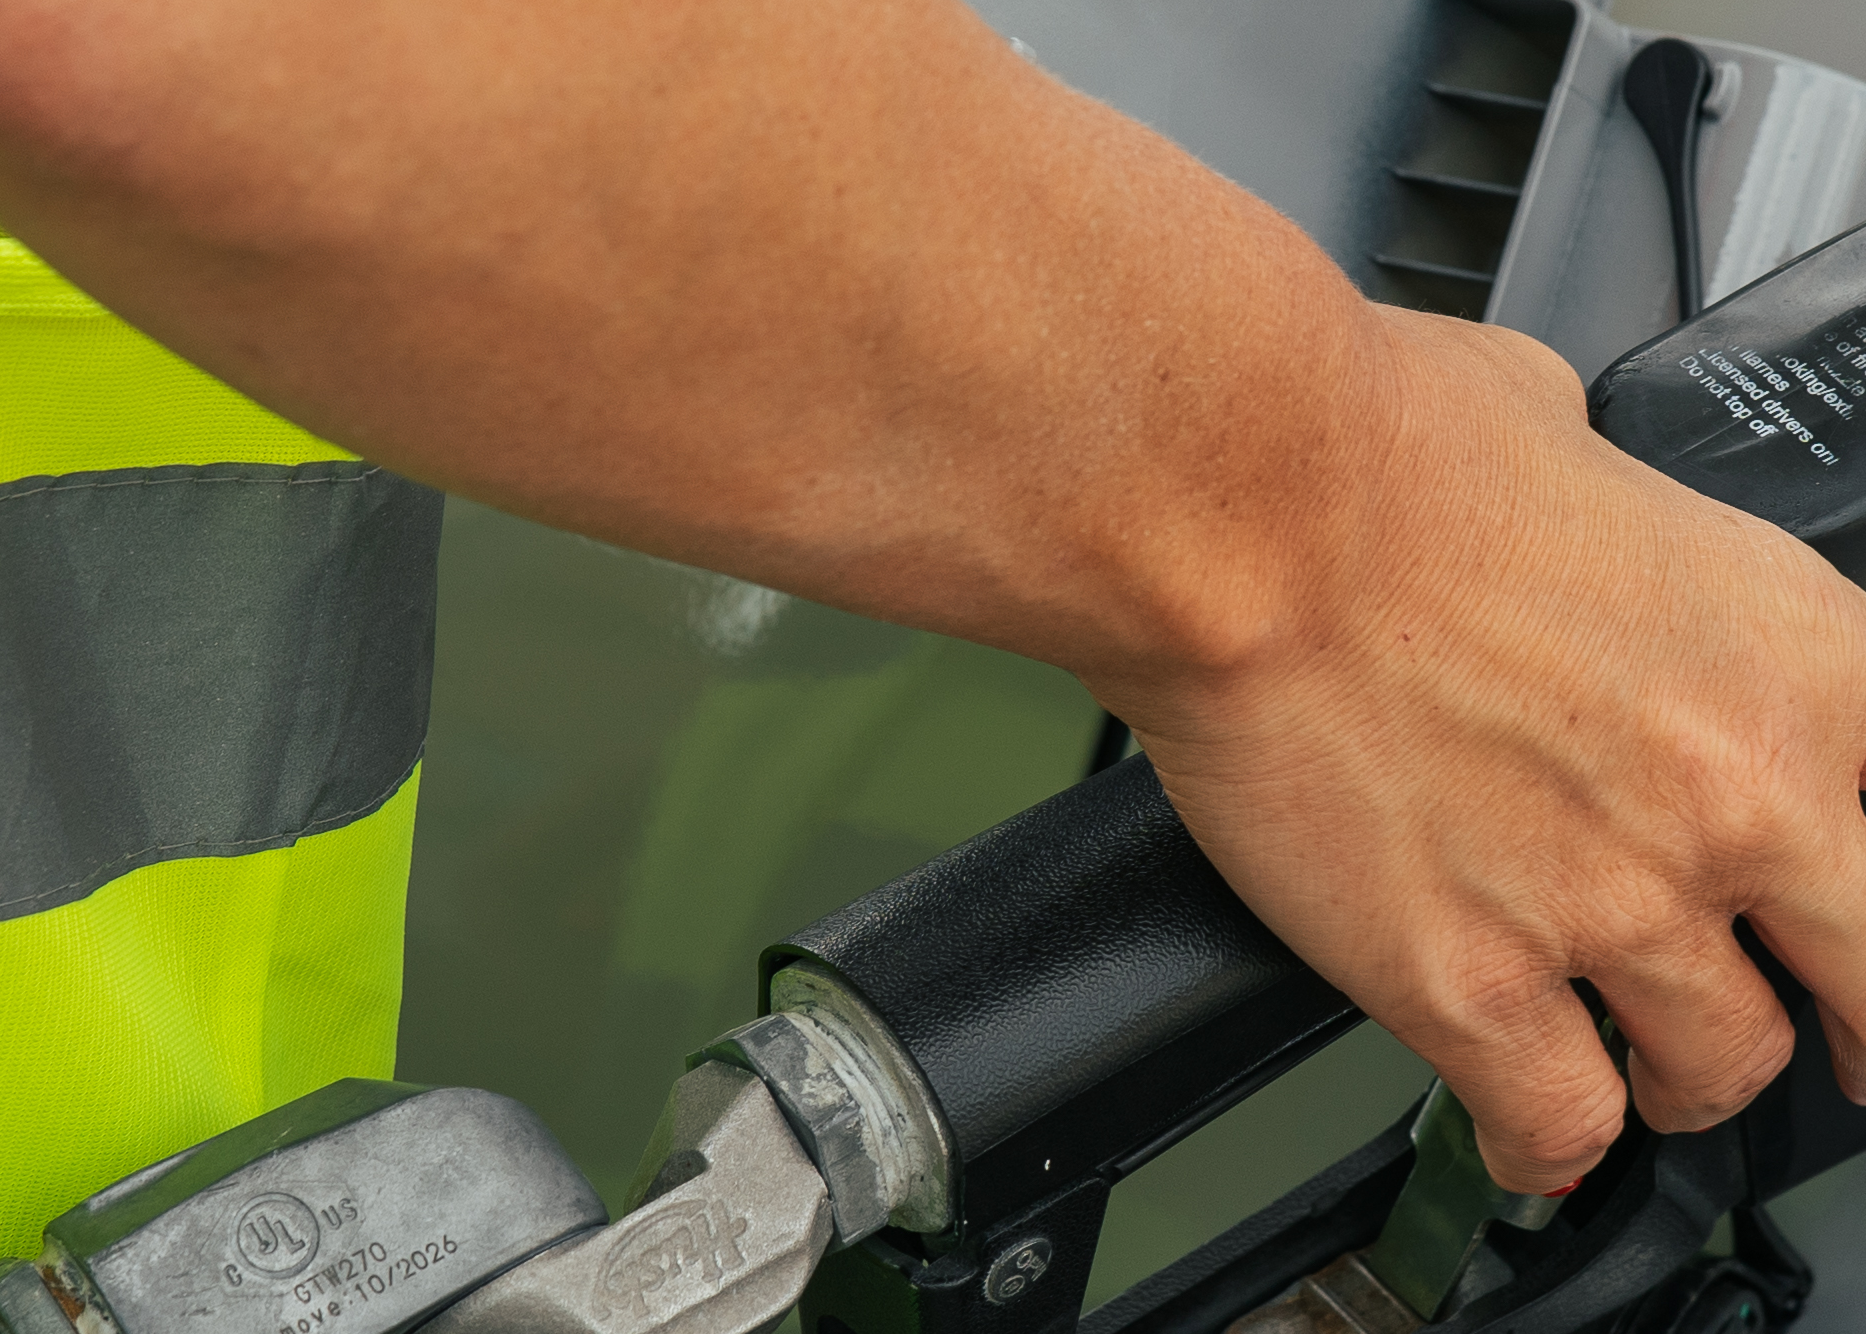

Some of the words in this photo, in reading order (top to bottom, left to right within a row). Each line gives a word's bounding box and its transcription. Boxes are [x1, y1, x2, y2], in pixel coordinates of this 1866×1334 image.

[1836, 341, 1862, 357] of
[1679, 355, 1704, 377] Do
[1699, 375, 1733, 399] not
[1724, 395, 1753, 420] top
[1748, 419, 1780, 438] off
[1761, 399, 1814, 443] drivers
[321, 1197, 359, 1230] US
[293, 1241, 388, 1305] GTW270
